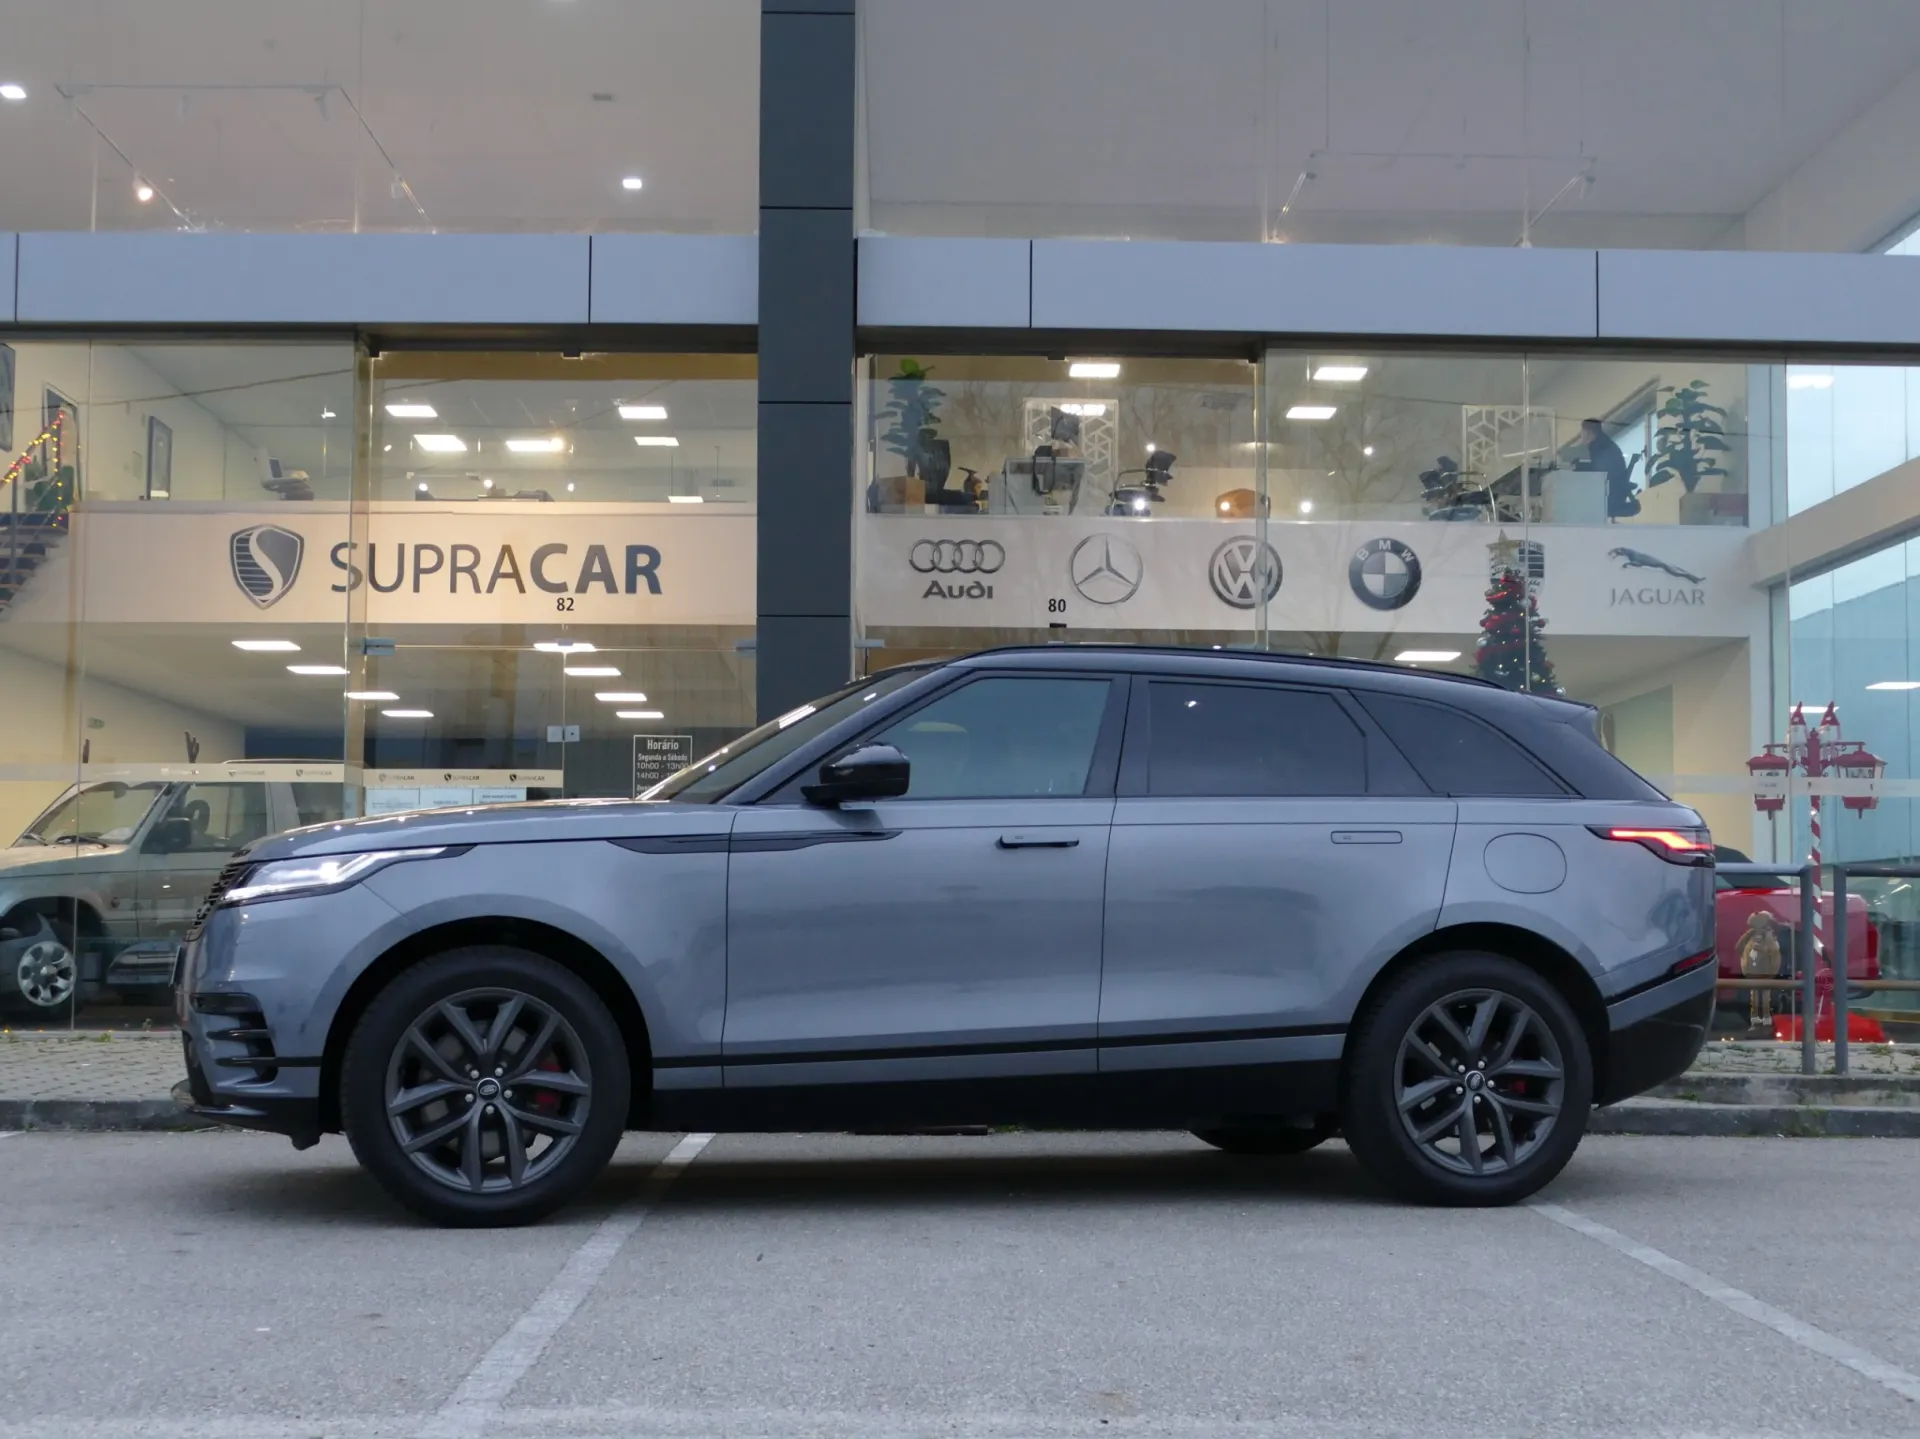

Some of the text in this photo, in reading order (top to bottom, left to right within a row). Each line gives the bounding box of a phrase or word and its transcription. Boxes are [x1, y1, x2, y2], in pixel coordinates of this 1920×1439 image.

[1356, 539, 1414, 562] BMW
[330, 541, 662, 595] SUPRACAR
[922, 580, 993, 599] Audi
[1609, 588, 1705, 606] JAGUAR
[556, 597, 575, 612] 82
[1048, 598, 1067, 613] 80
[647, 739, 679, 750] Horário
